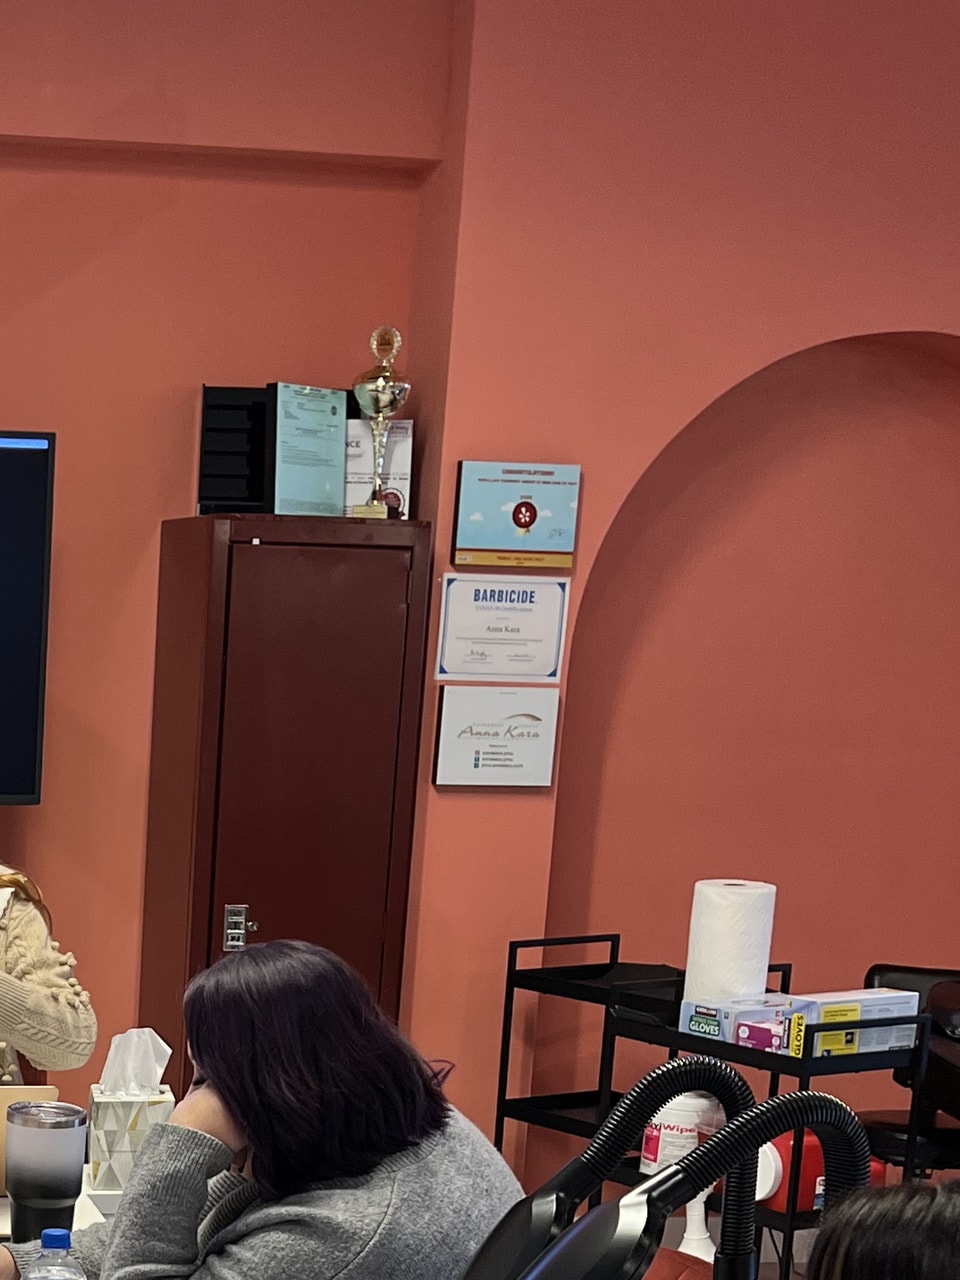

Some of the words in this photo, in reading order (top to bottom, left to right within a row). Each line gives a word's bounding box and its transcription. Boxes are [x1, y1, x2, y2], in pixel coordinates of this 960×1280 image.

[473, 588, 535, 604] BARBICIDE
[690, 1020, 720, 1035] GLOVES
[794, 1014, 804, 1056] GLOVES
